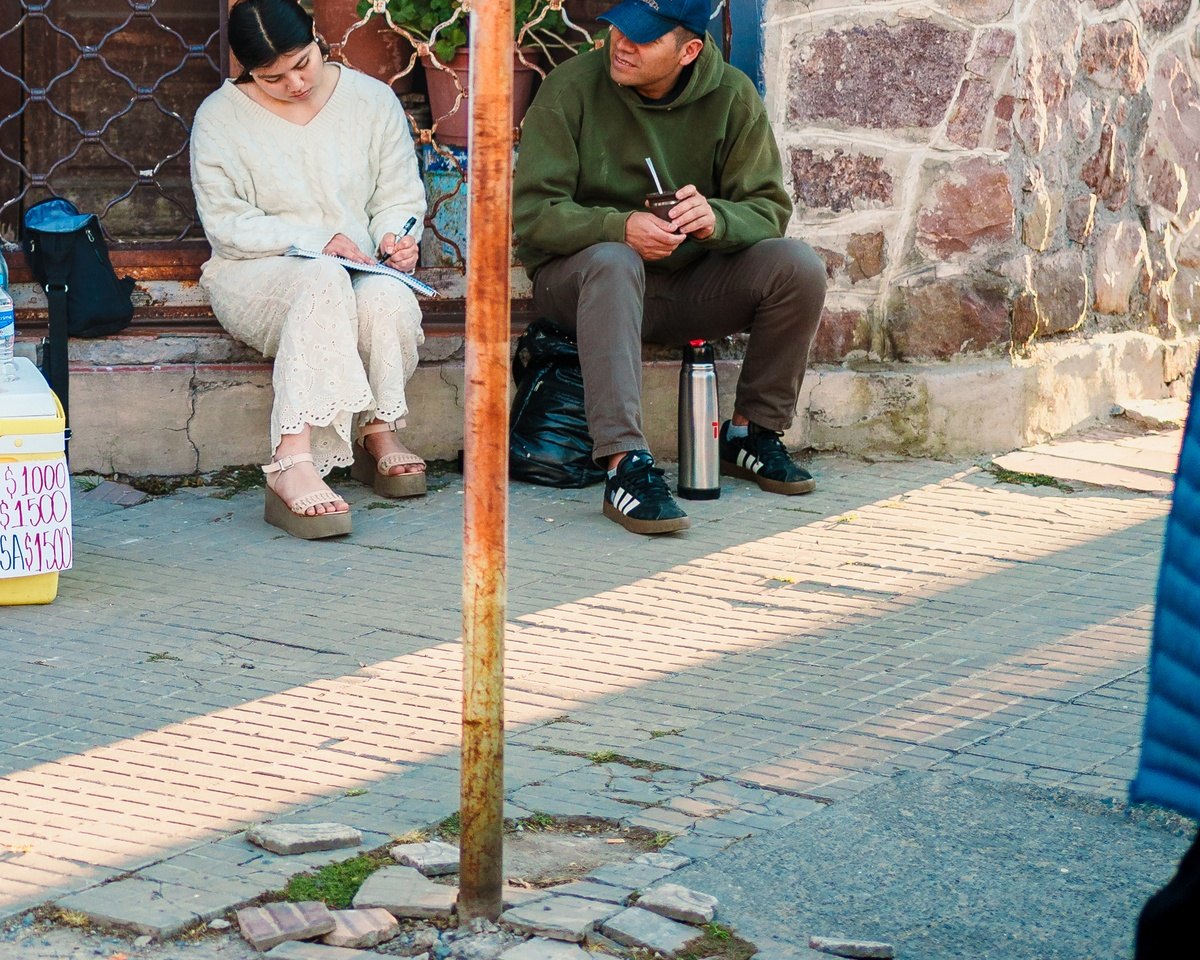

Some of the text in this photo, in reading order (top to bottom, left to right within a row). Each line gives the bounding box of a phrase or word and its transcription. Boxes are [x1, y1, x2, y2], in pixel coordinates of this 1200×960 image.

[4, 462, 67, 499] $1000
[0, 490, 68, 530] $1500
[24, 526, 72, 572] $1500
